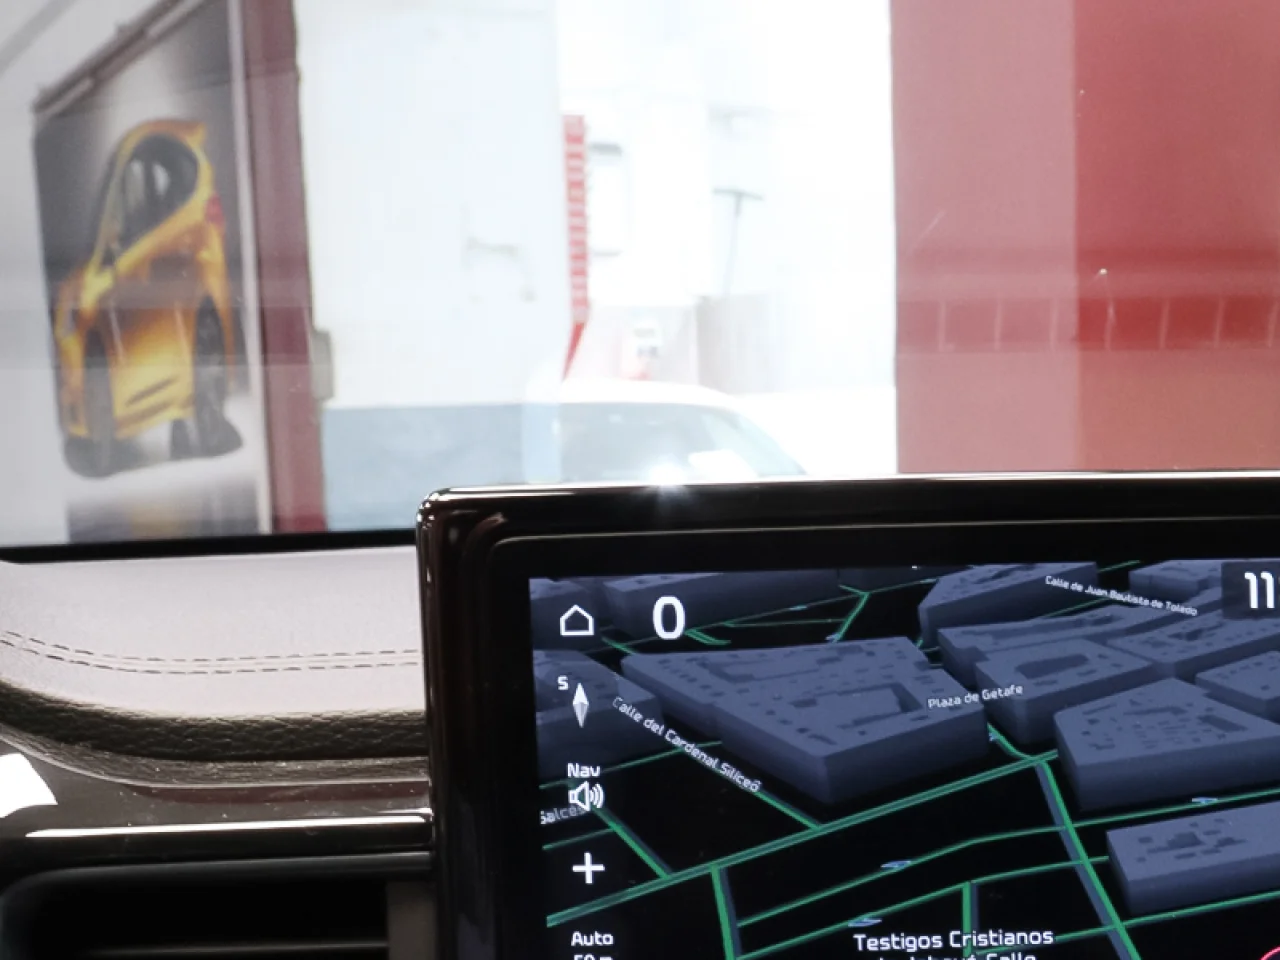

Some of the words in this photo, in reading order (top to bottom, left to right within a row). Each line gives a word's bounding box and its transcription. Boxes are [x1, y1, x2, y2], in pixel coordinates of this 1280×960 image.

[1045, 575, 1069, 589] Calle
[1071, 581, 1084, 592] de
[1085, 584, 1108, 597] Juan
[1110, 588, 1150, 606] Bautista
[1151, 598, 1163, 609] de
[1165, 600, 1198, 616] Toledo
[653, 596, 686, 640] 0
[928, 696, 961, 709] Plaza
[965, 690, 979, 704] de
[982, 684, 1024, 701] Getafe
[612, 696, 643, 722] Calle
[643, 718, 665, 736] del
[664, 728, 719, 769] Cardenal
[567, 762, 601, 778] Nav
[571, 930, 614, 946] Auto
[853, 933, 943, 953] Testigos
[948, 929, 1054, 949] Cristianos
